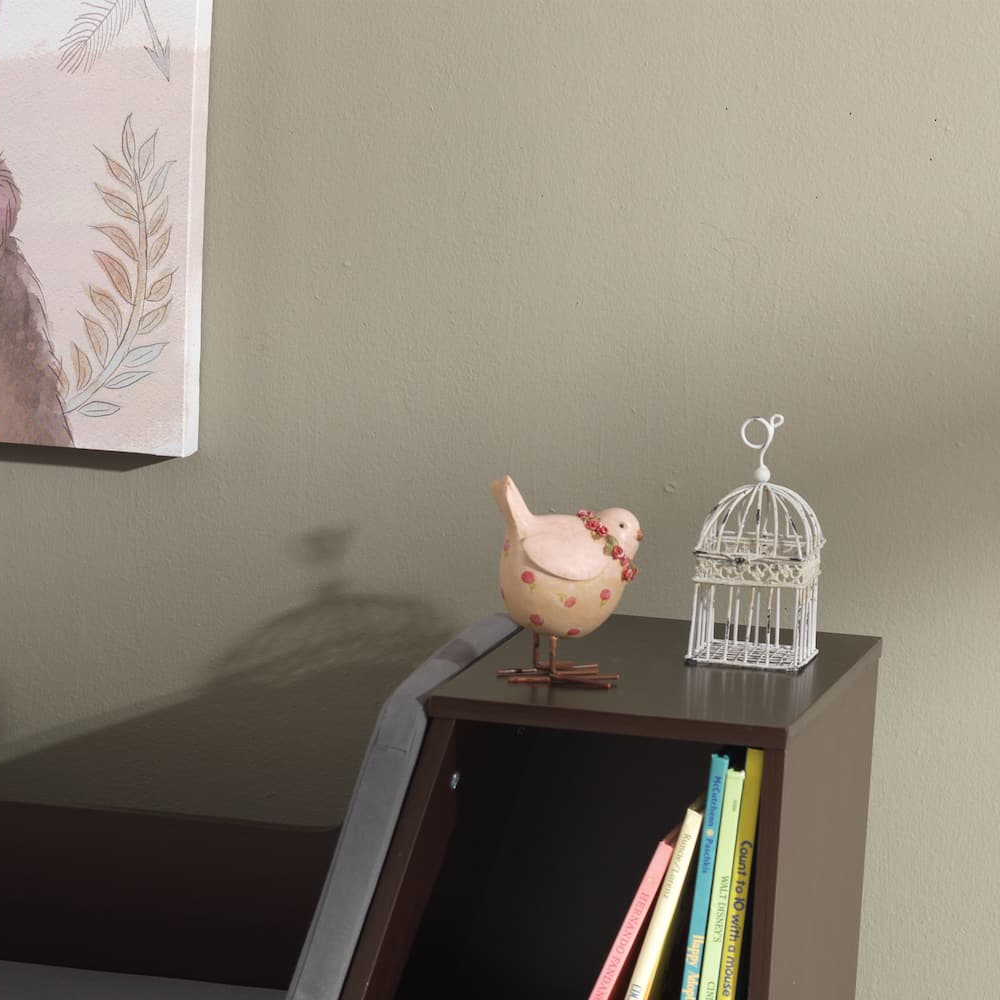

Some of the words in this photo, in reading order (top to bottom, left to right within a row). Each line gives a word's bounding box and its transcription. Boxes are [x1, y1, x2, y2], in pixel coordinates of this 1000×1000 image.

[738, 839, 752, 876] Count
[719, 875, 729, 899] WALT
[736, 879, 746, 894] to
[734, 896, 744, 911] 10
[615, 891, 649, 954] HERNANDO
[713, 901, 726, 943] DISNEY'S
[730, 914, 741, 942] with
[687, 933, 704, 968] Happy
[729, 944, 736, 953] a
[722, 955, 735, 997] mouse
